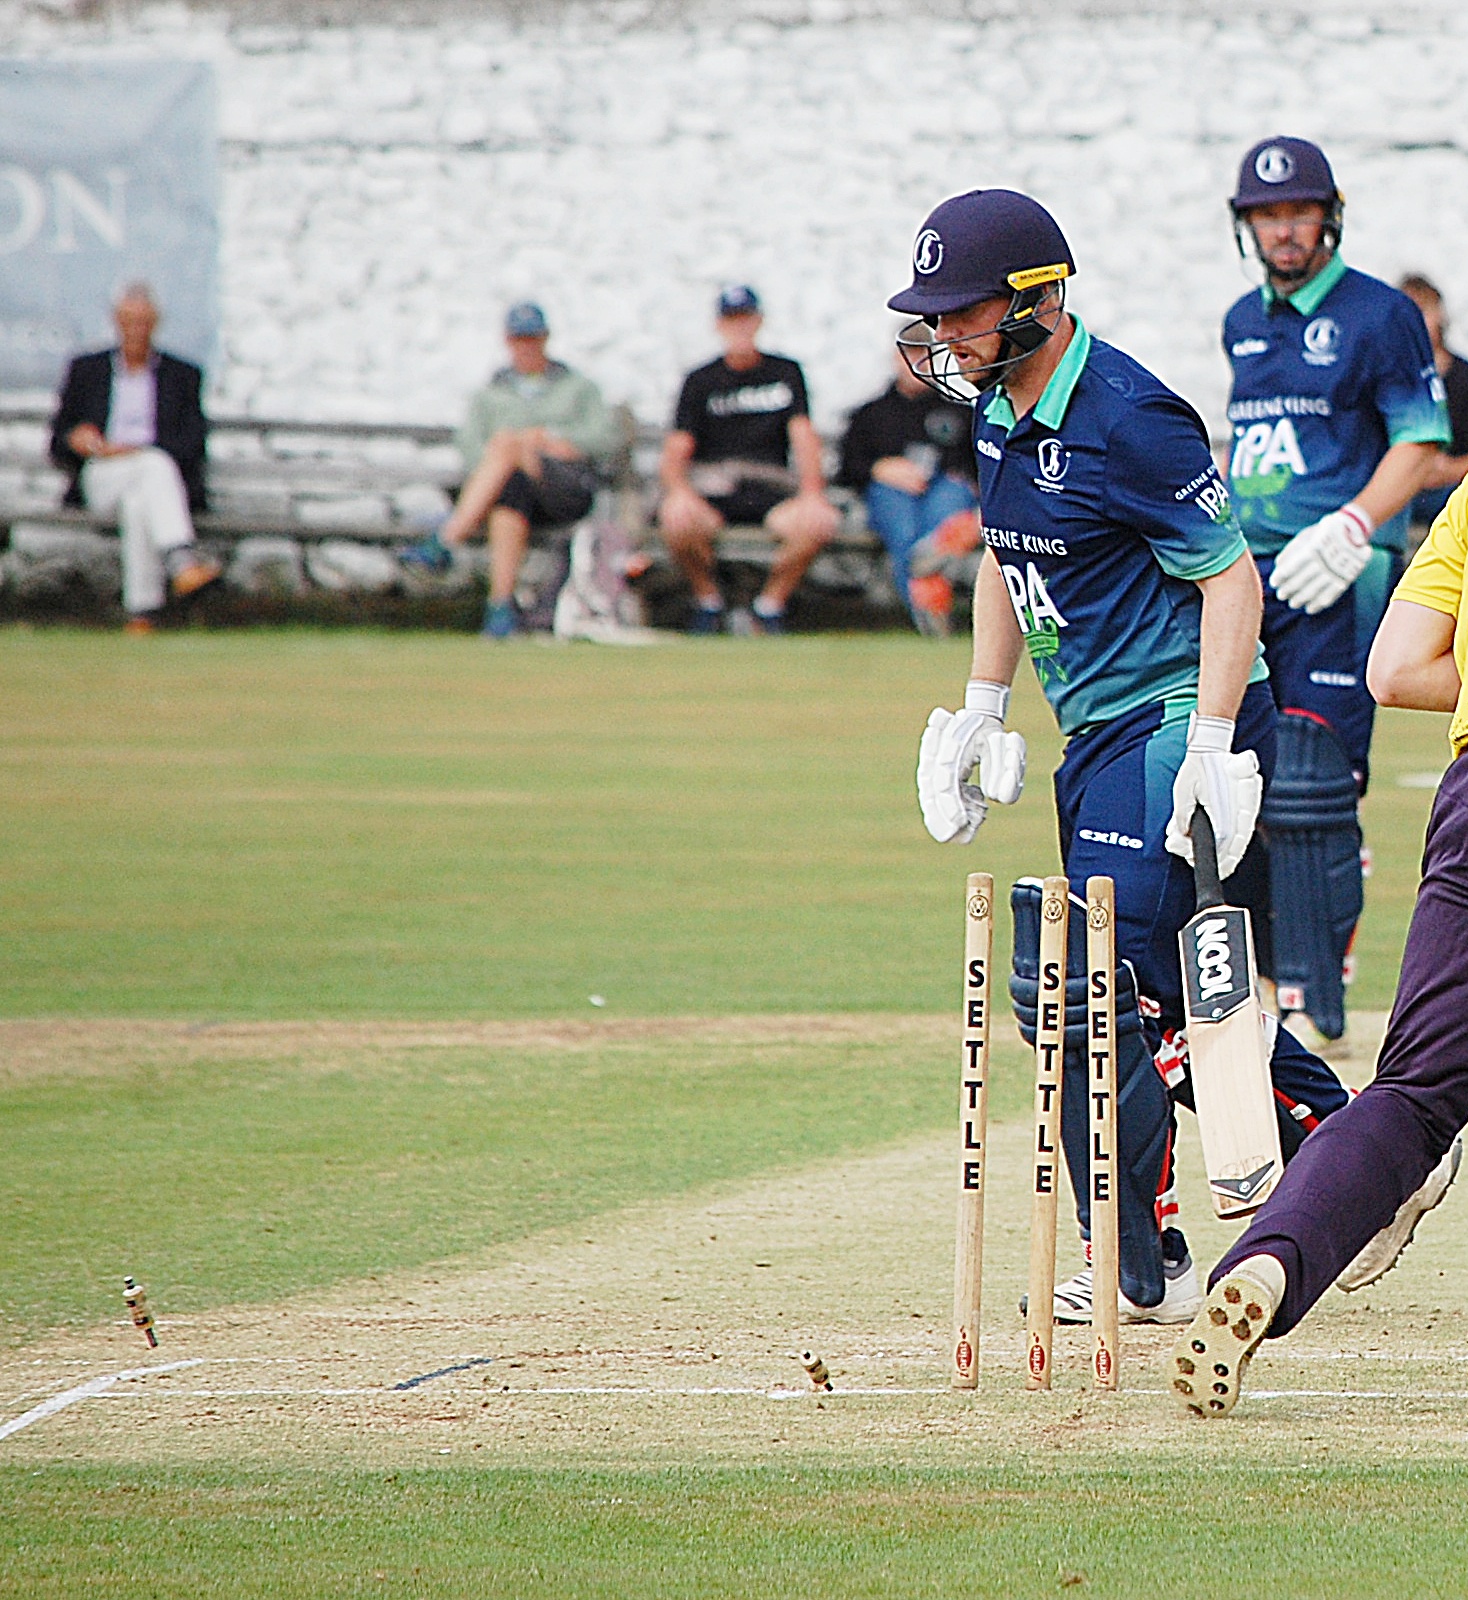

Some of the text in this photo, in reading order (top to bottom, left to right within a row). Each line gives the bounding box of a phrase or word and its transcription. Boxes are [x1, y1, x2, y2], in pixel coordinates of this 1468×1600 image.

[1022, 533, 1068, 556] KING
[1195, 918, 1234, 1001] ICON
[964, 960, 985, 1190] SETTLE
[1035, 962, 1060, 1193] SETTLE
[1091, 970, 1110, 1201] SETTLE
